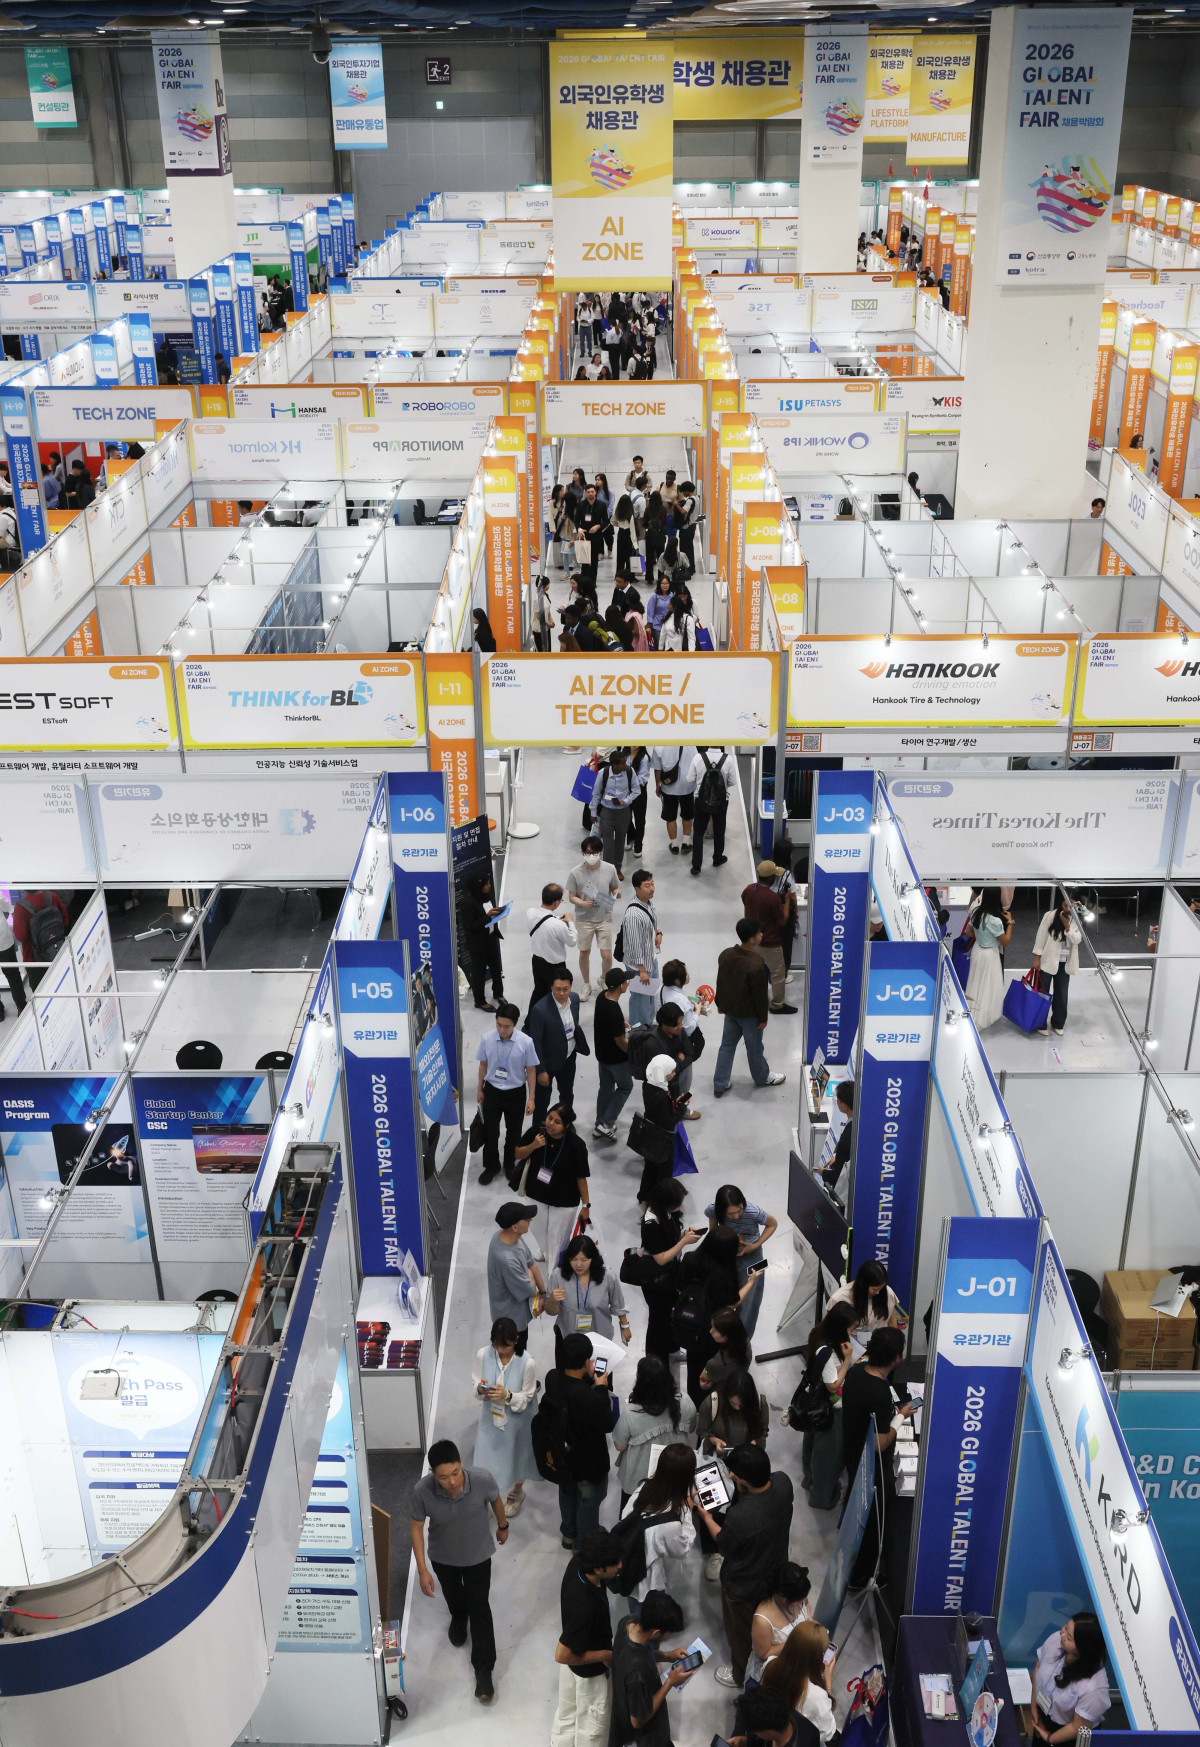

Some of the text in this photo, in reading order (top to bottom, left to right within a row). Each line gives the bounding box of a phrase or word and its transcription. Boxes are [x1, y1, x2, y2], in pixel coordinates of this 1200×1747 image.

[816, 42, 840, 50] 2026
[1025, 44, 1074, 60] 2026
[158, 48, 182, 57] 2026
[332, 59, 380, 68] 외국인투자기업
[881, 60, 904, 69] 채용관
[916, 56, 970, 67] 외국인유학생
[346, 70, 367, 79] 채용관
[444, 64, 450, 75] 2
[722, 60, 792, 86] 채용관
[928, 70, 956, 80] 채용관
[1022, 66, 1099, 82] GLOBAL
[560, 84, 664, 105] 외국인유학생
[1022, 89, 1094, 105] TALENT
[38, 102, 70, 112] 컨설팅관
[872, 109, 908, 117] LIFESTYLE
[336, 118, 384, 131] 판매유통업
[586, 110, 638, 130] 채용관
[870, 120, 908, 128] PLATFORM
[1020, 112, 1104, 128] FAIR 채용박람회
[910, 132, 966, 142] MANUFACTURE
[600, 216, 624, 236] AI
[582, 242, 644, 260] ZONE
[4, 402, 23, 411] H-19
[412, 402, 475, 411] ROBOROBO
[716, 397, 733, 405] J-15
[72, 407, 157, 420] TECH ZONE
[582, 403, 665, 416] TECH ZONE
[502, 436, 519, 445] I-14
[726, 432, 745, 442] J-10
[736, 473, 760, 484] J-09
[750, 525, 777, 537] J-08
[494, 573, 504, 597] 채용관
[439, 683, 461, 696] I-11
[570, 673, 692, 696] AI ZONE /
[912, 680, 997, 690] driving emotion
[935, 696, 981, 706] Technology
[555, 704, 705, 725] TECH ZONE
[52, 762, 138, 771] 유틸리티 소프트웨어 개발
[256, 759, 358, 768] 인공지능 신뢰성 기술서비스업
[456, 751, 470, 824] 2026 GLOBA
[401, 807, 435, 822] I-06
[824, 808, 865, 822] J-03
[402, 848, 438, 858] 유관기관
[824, 849, 861, 858] 유관기관
[416, 886, 430, 920] 2026
[826, 887, 847, 1058] 2026 GLOBAL TALENT FAIR
[352, 983, 393, 999] I-05
[876, 985, 926, 1001] J-02
[353, 1031, 398, 1041] 유관기관
[876, 1033, 921, 1043] 유관기관
[371, 1074, 388, 1114] 2026
[144, 1100, 176, 1109] Global
[5, 1111, 50, 1120] Program
[145, 1110, 223, 1121] Startup Center
[375, 1117, 392, 1177] GLOBAL
[877, 1078, 902, 1240] 2026 GLOBAL TALENT
[380, 1179, 397, 1234] TALENT
[958, 1277, 1017, 1296] J-01
[953, 1334, 1011, 1346] 유관기관
[144, 1379, 183, 1390] Pass
[943, 1386, 985, 1611] 2026 GLOBAL TALENT FAIR
